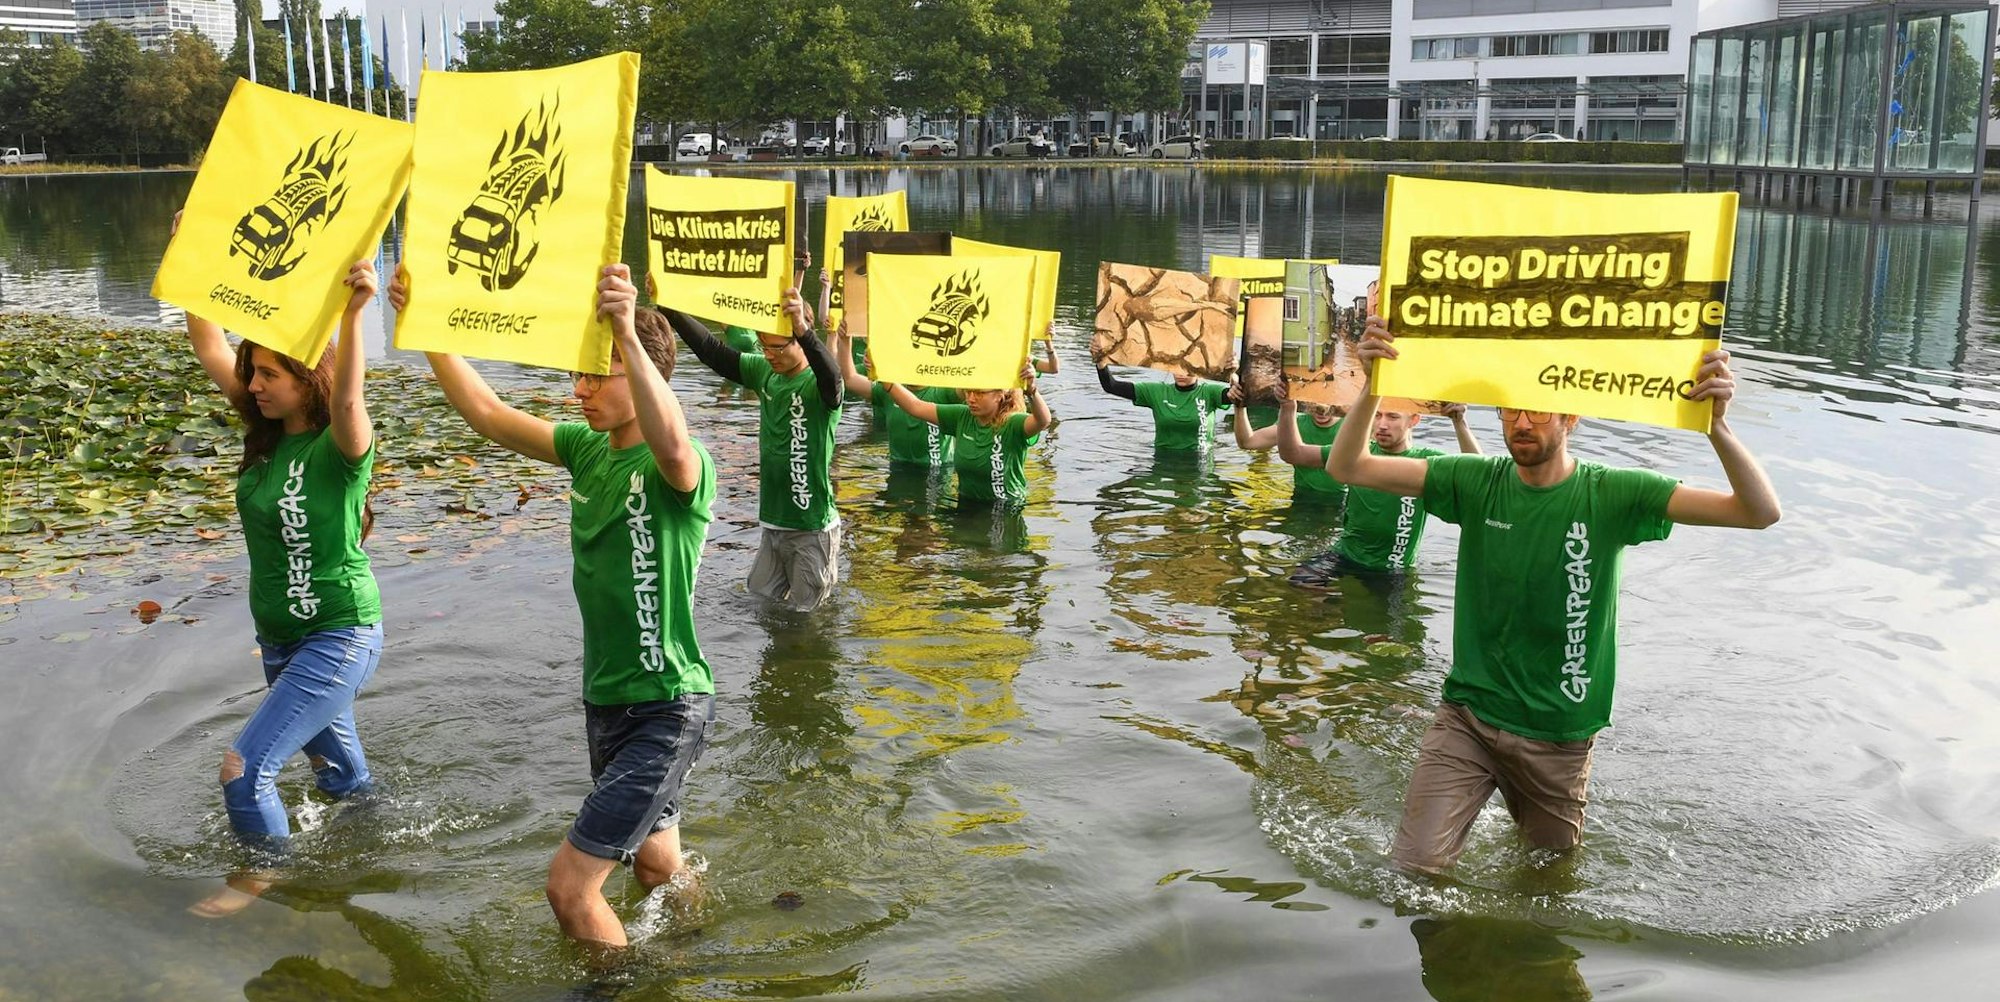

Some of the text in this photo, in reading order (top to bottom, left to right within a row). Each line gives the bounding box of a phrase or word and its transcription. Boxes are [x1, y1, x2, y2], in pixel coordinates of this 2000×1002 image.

[651, 213, 780, 240] Die Klimakrise
[665, 247, 765, 273] startet hier
[1420, 245, 1671, 288] Stop Driving
[209, 283, 280, 320] GREENPEACE
[712, 291, 780, 317] GREENPEACE
[1401, 294, 1725, 336] Climate Change
[447, 307, 537, 335] GREENPEACE
[916, 364, 976, 376] GREENPEACE
[1538, 364, 1695, 401] GREENPEAC
[789, 392, 813, 511] GREENPEACE
[277, 459, 321, 620] GREENPEACE
[625, 470, 664, 673] GREENPEACE
[1559, 521, 1593, 703] GREENPEACE
